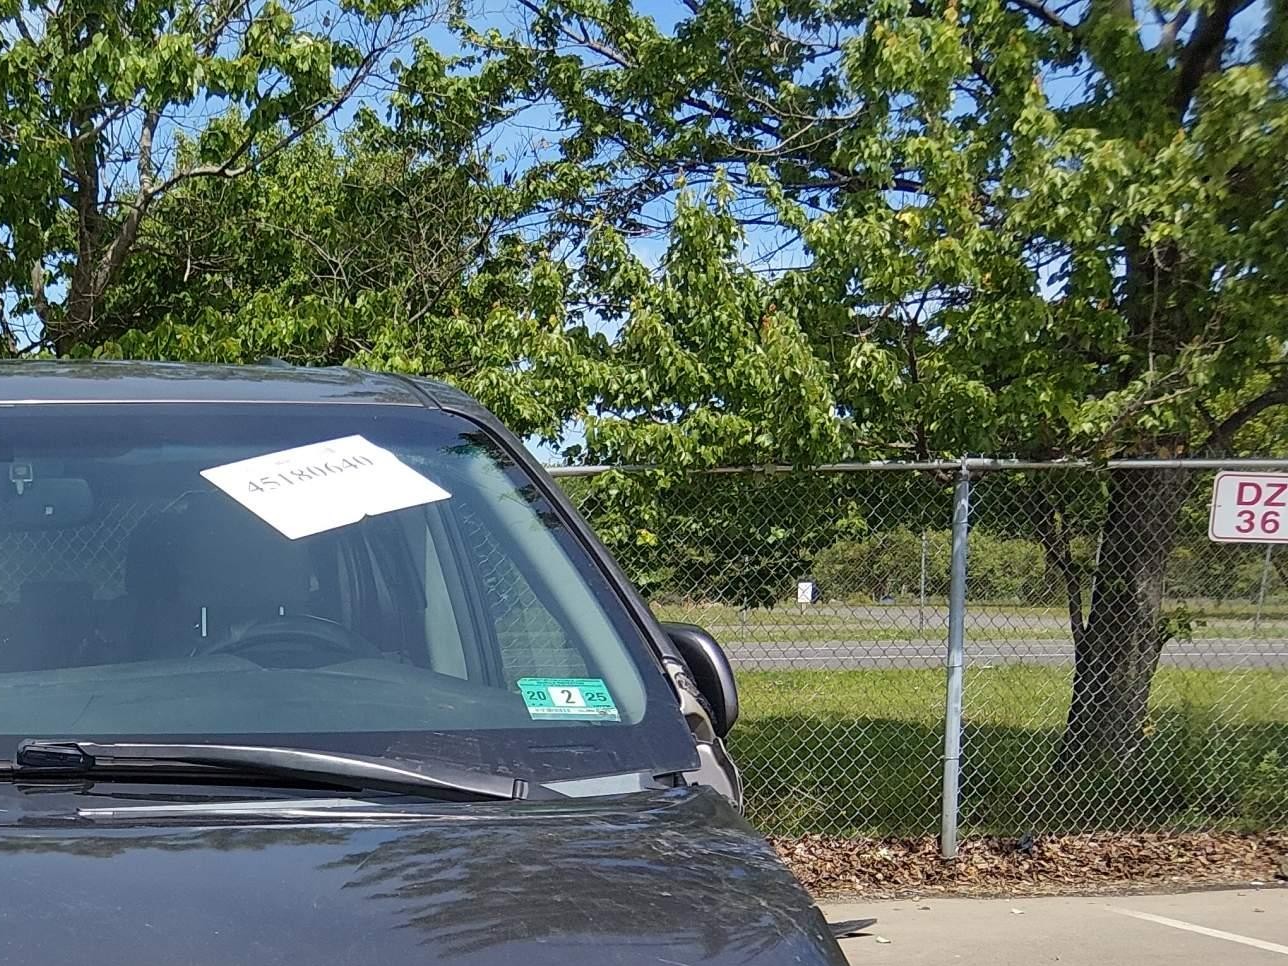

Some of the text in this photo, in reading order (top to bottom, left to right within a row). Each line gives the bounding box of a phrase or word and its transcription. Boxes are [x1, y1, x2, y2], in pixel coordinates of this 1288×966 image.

[247, 455, 374, 493] 45180640
[1236, 482, 1288, 507] DZ
[1235, 509, 1280, 533] 36
[526, 689, 607, 704] 20 2 25
